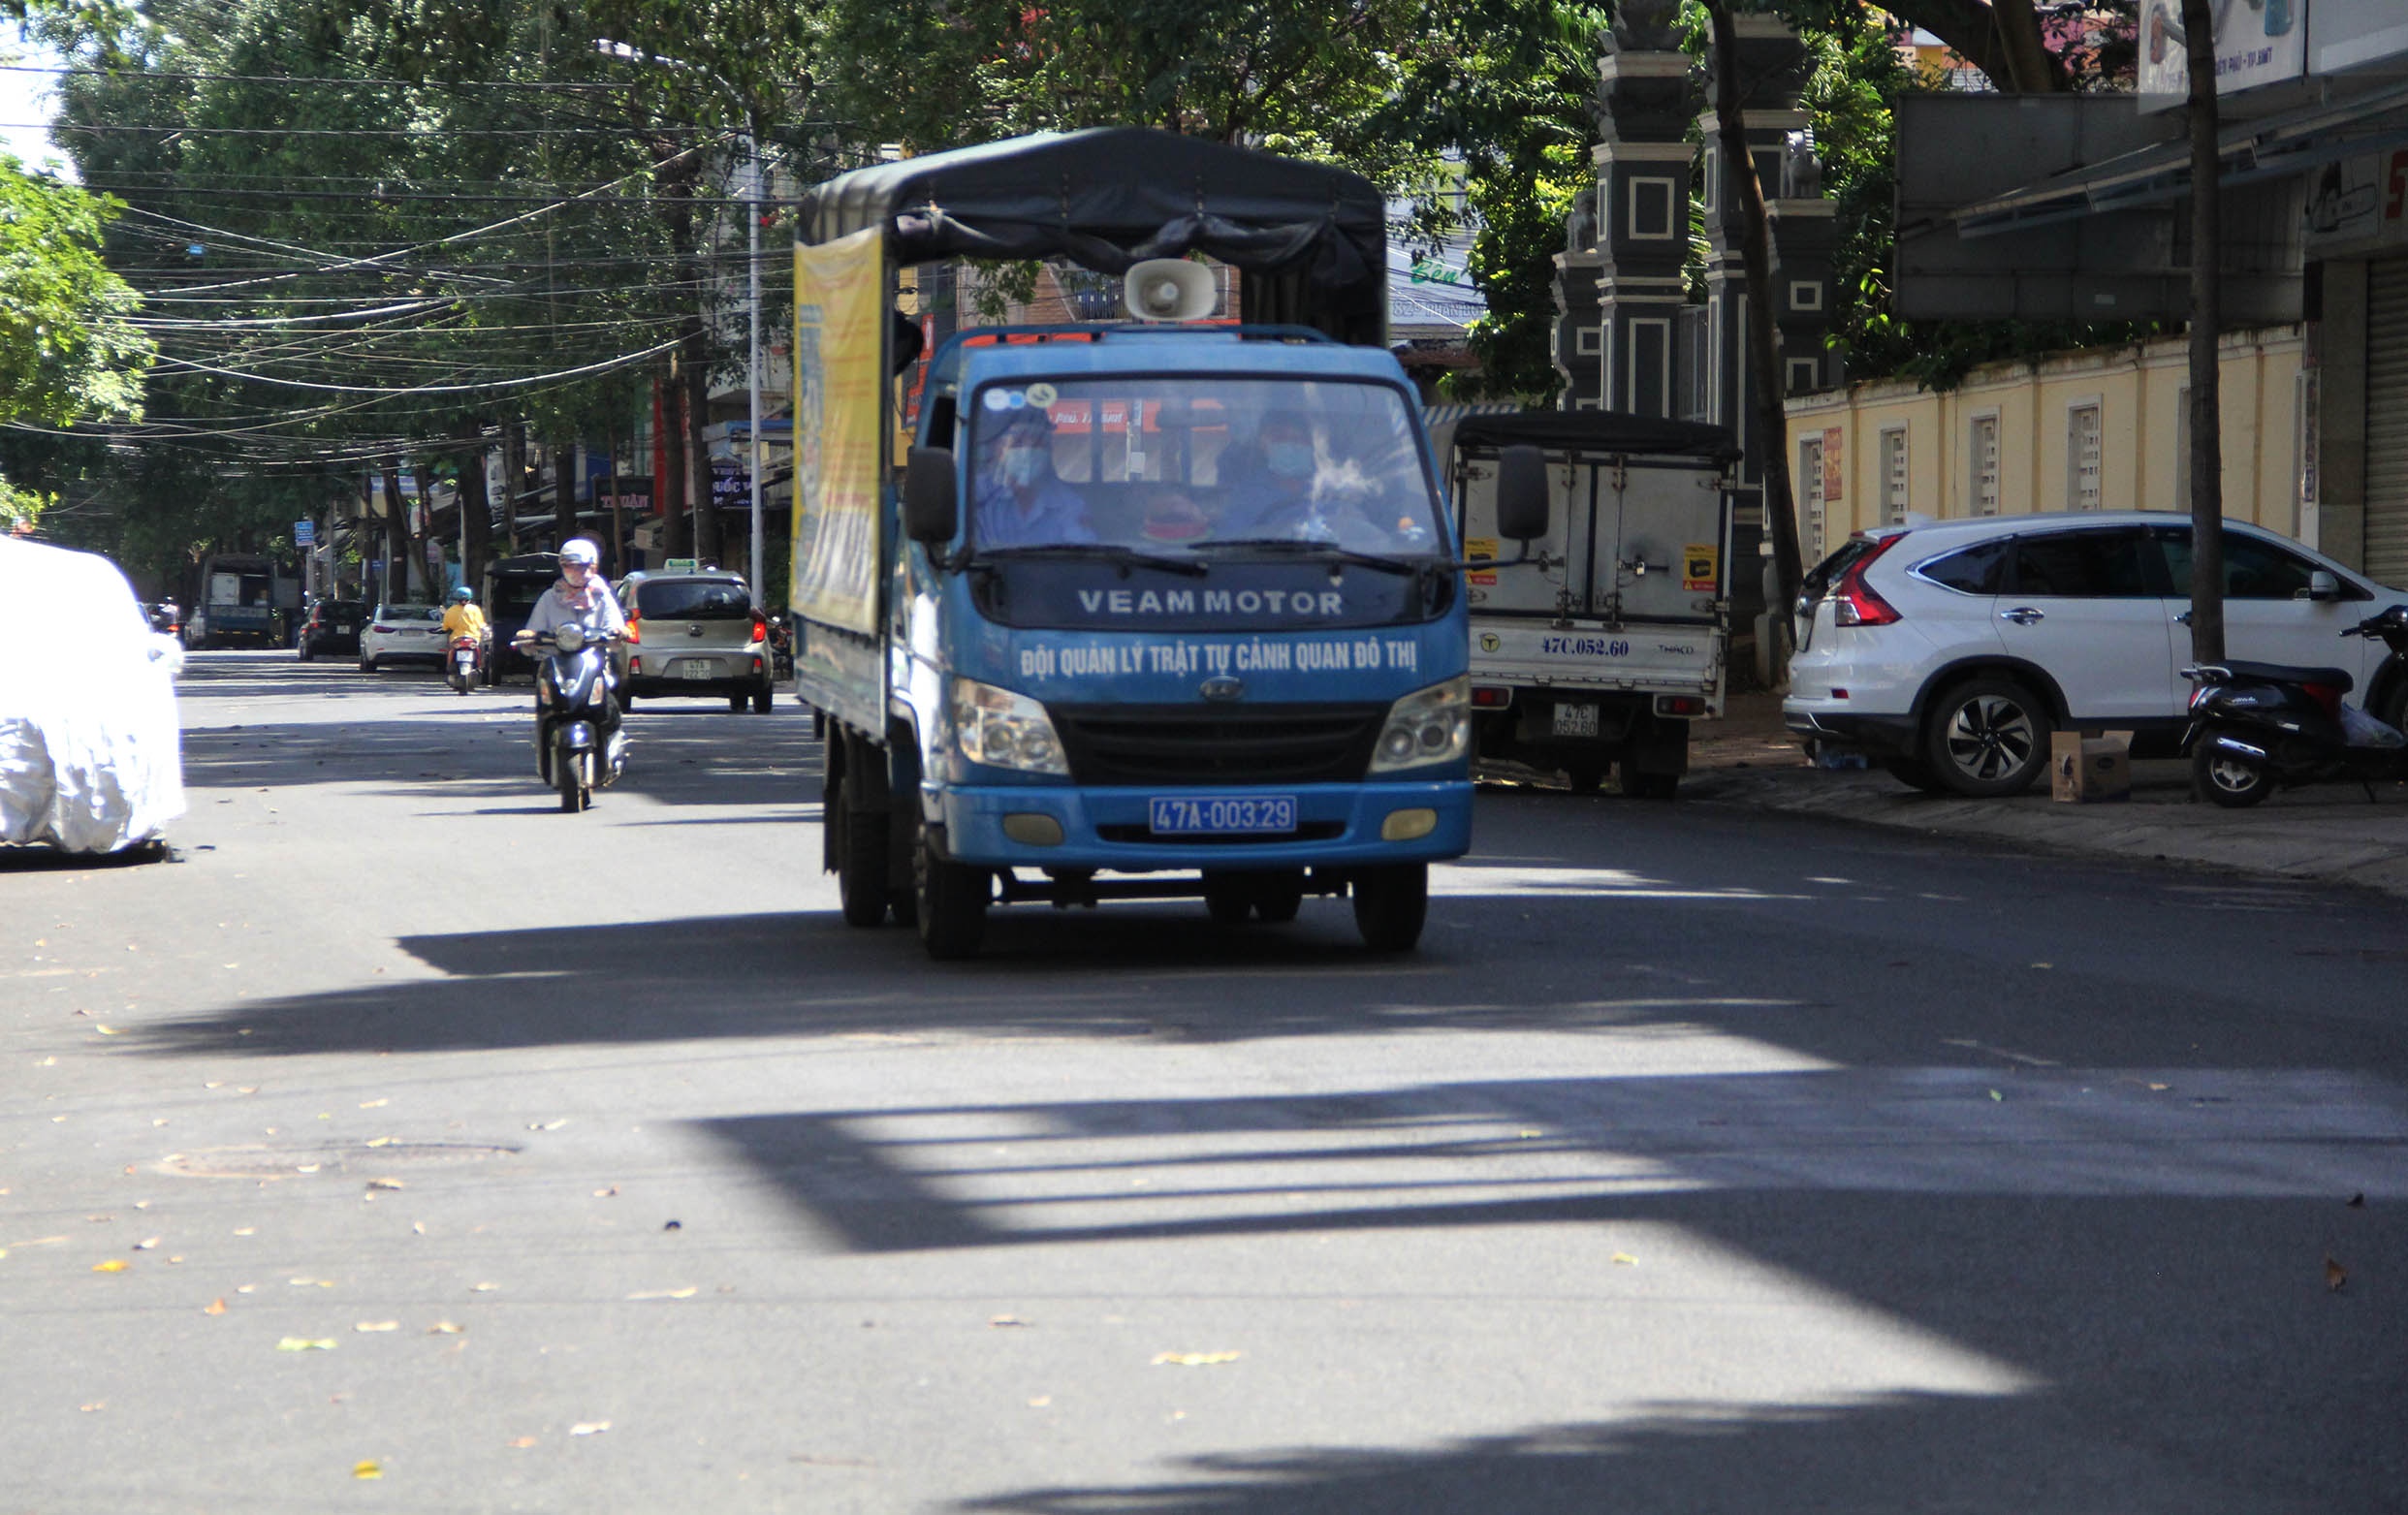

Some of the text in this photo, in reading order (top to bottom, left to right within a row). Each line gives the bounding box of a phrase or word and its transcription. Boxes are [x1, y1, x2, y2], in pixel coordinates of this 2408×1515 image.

[1077, 588, 1344, 615] VEAM MOTOR
[1021, 636, 1418, 680] ĐỘI QUẢN LÝ TRẬT TỰ CẢNH QUAN ĐÔ THỊ
[1541, 635, 1630, 657] 47C.052.60
